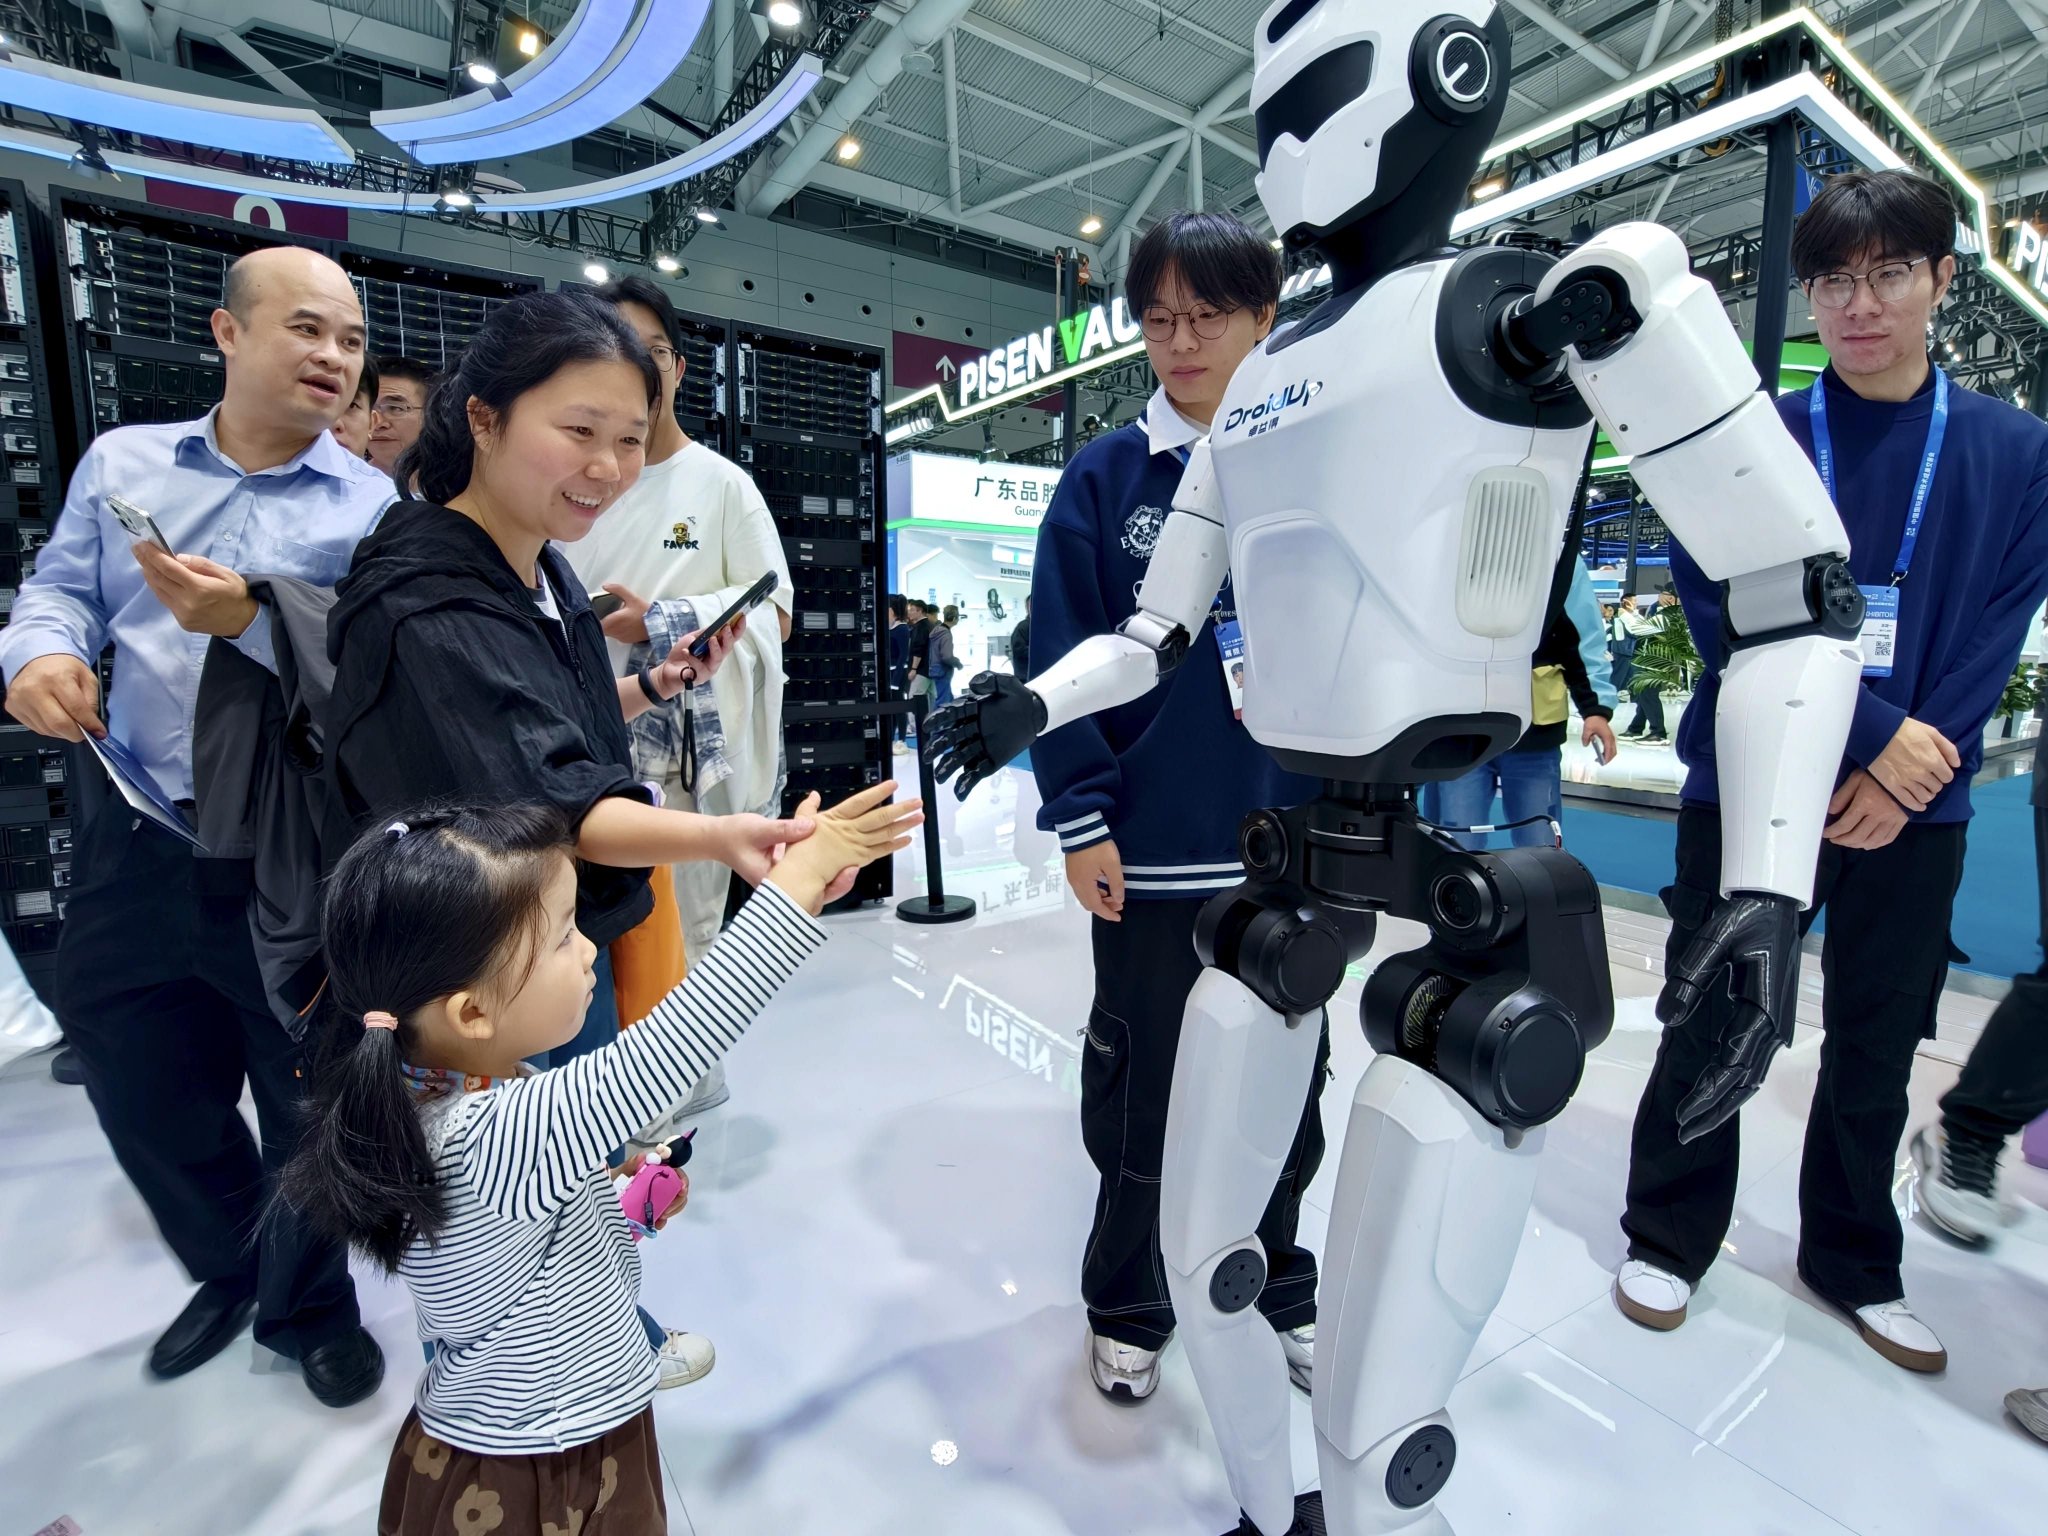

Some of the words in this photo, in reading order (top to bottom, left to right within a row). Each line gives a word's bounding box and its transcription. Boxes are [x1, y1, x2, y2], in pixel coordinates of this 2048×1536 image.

[960, 325, 1055, 407] PISEN
[1224, 379, 1323, 433] DroidUp
[663, 539, 700, 551] FAVOR
